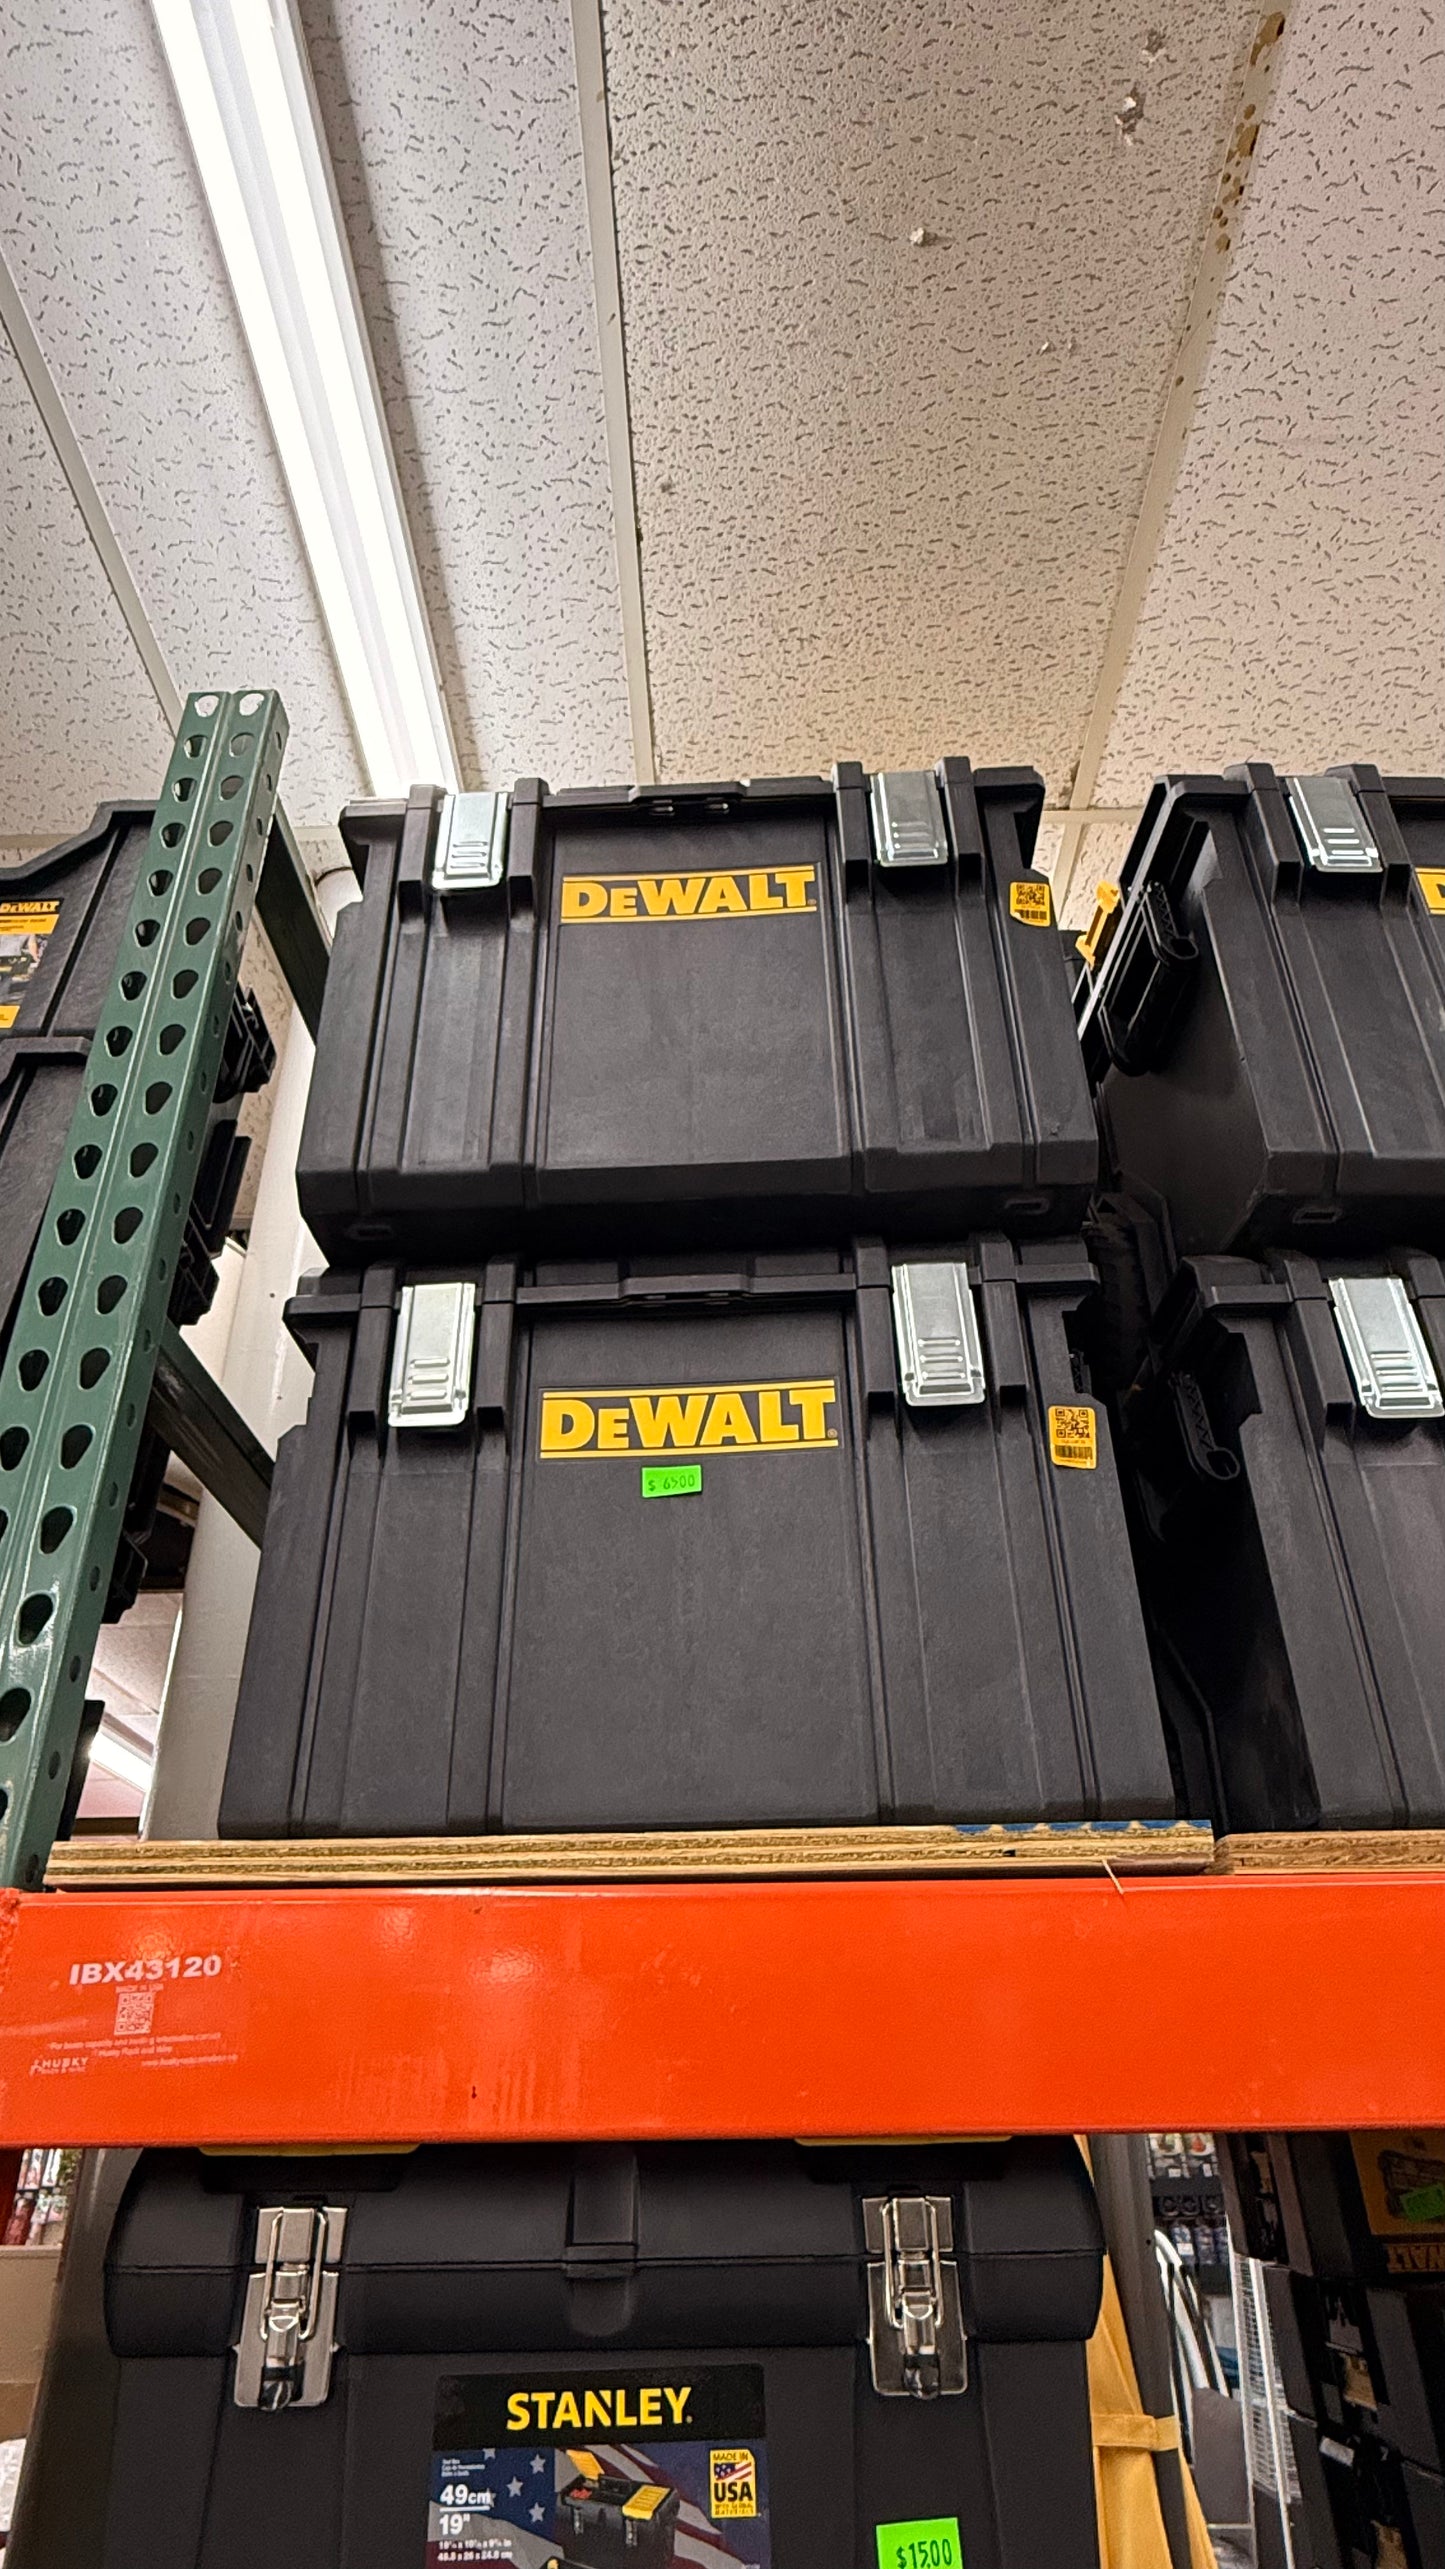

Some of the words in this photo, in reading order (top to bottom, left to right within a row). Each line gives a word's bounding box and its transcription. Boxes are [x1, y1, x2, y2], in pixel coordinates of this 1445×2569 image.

[69, 1954, 222, 1986] IBX43120
[506, 2386, 692, 2431] STANLEY
[713, 2481, 753, 2503] USA
[439, 2513, 471, 2536] 19"
